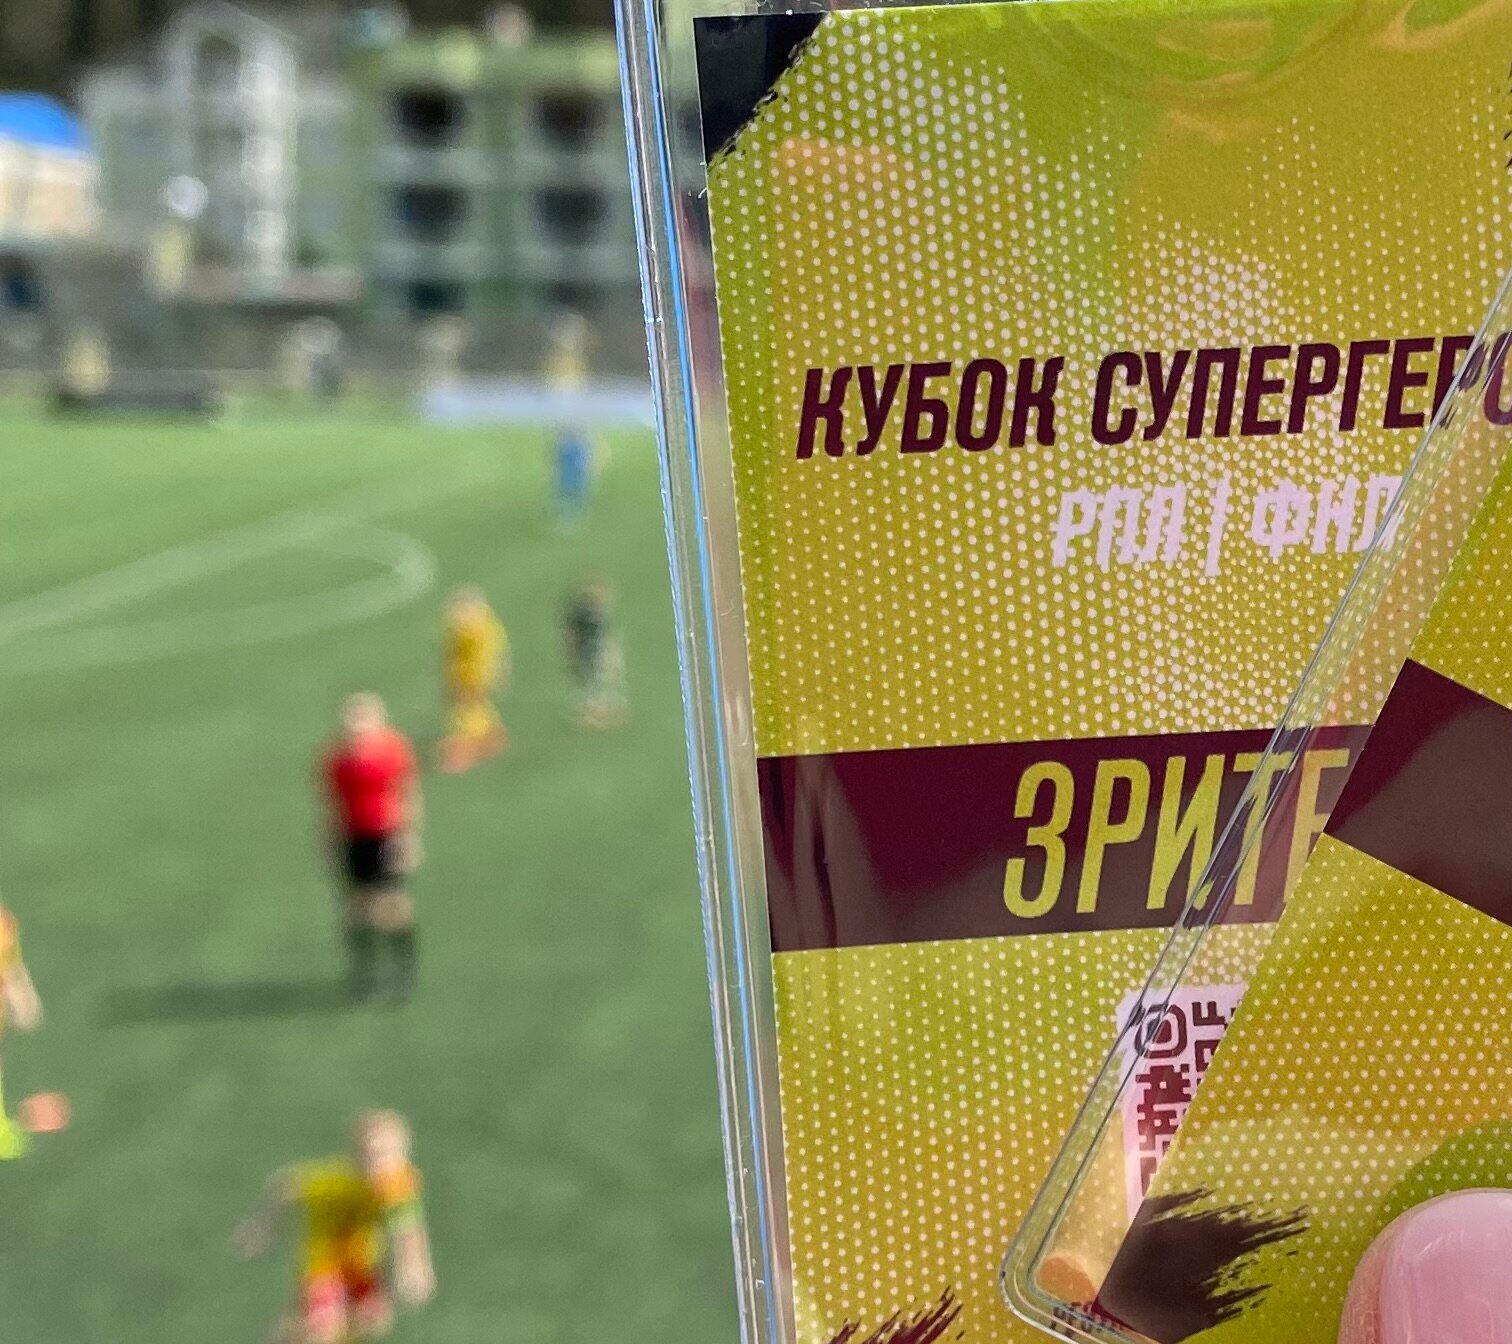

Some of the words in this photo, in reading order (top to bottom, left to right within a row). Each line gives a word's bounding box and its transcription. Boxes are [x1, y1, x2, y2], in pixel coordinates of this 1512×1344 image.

[796, 356, 1065, 459] КУБОК
[1051, 481, 1186, 571] РПЛ
[1252, 474, 1407, 558] ФНЛ
